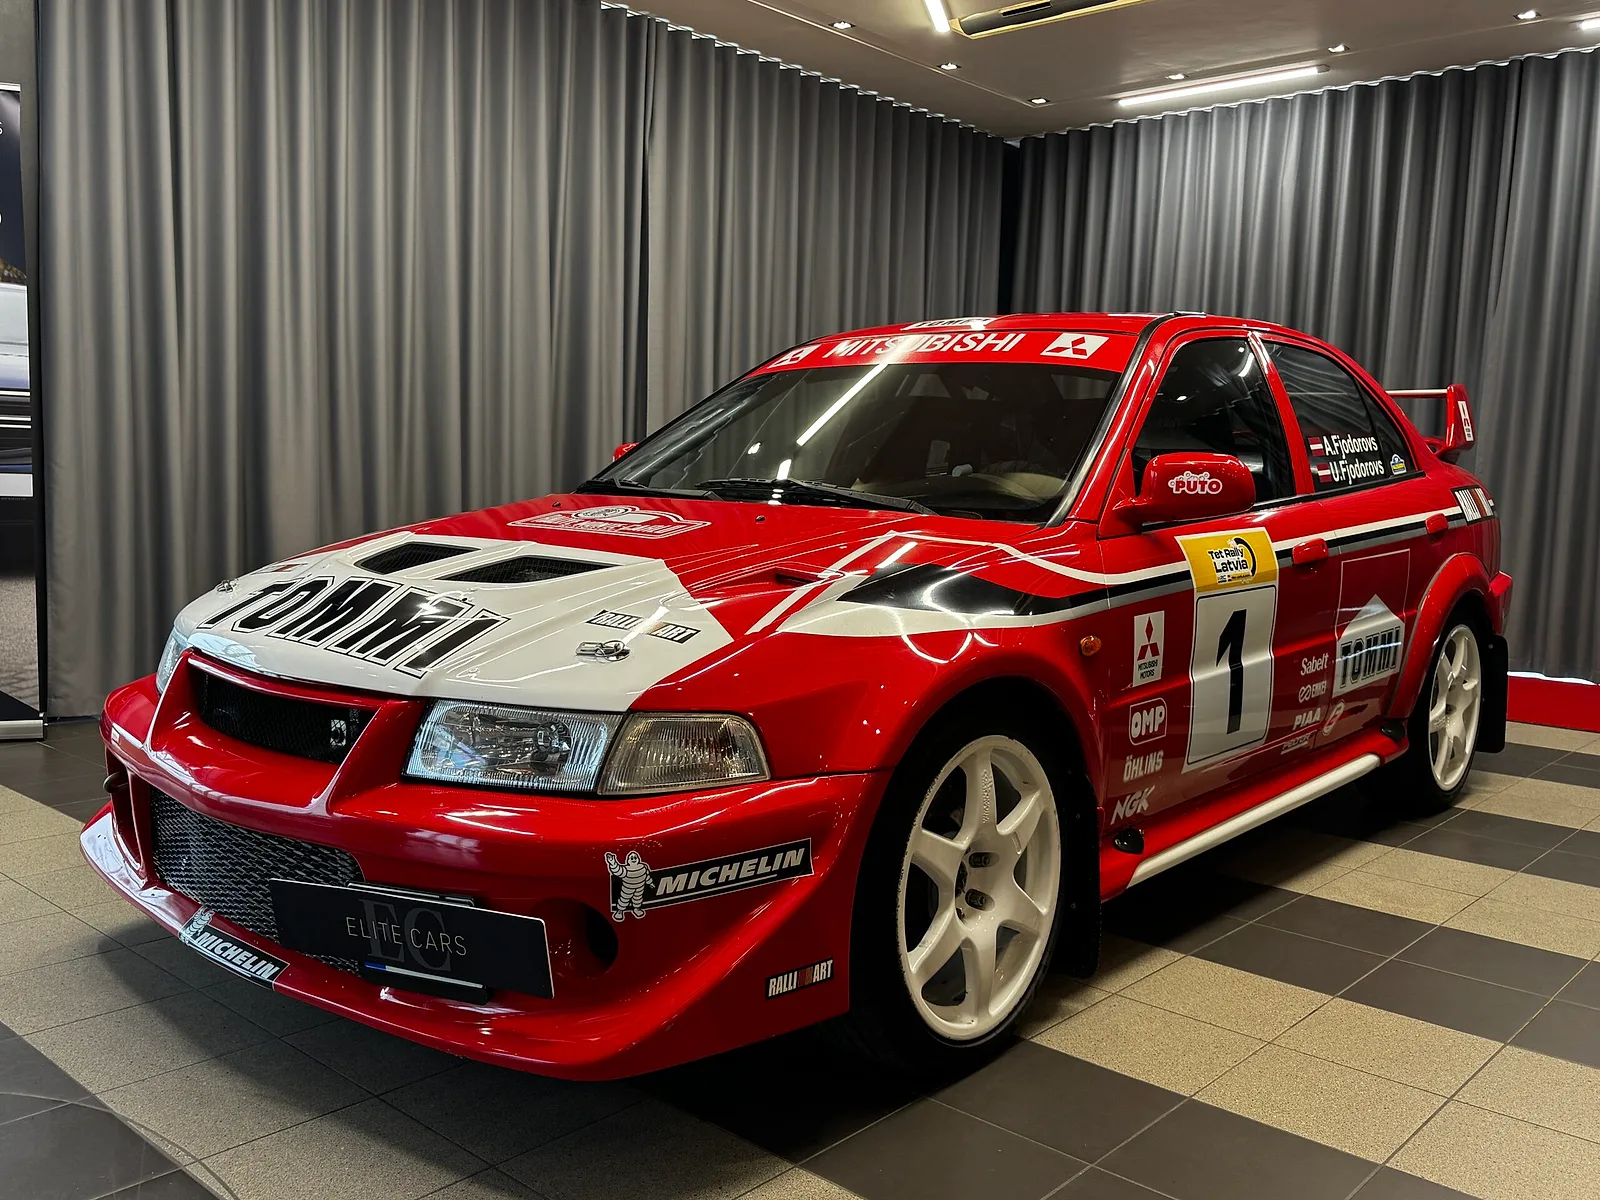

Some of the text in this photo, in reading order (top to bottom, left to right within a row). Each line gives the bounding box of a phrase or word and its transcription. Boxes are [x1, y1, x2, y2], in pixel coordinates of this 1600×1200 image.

[1323, 433, 1378, 459] A.Fjodorovs
[1174, 479, 1222, 494] PUTO
[1329, 458, 1384, 485] U.Fjodorovs
[1208, 547, 1244, 559] Tet Rally
[1213, 557, 1249, 573] Latvia
[196, 575, 511, 680] TOMMI
[1216, 608, 1247, 735] 1
[1300, 652, 1329, 676] Sabelt
[1340, 626, 1401, 689] TOMMI
[1140, 669, 1155, 680] MOTORS
[1131, 705, 1165, 738] OMP
[1292, 707, 1321, 731] PIAA
[1123, 750, 1164, 783] ÖHLINS
[1110, 785, 1155, 825] NGK
[656, 848, 805, 896] MICHELIN
[346, 916, 467, 956] ELITE CARS
[195, 931, 280, 979] MICHELIN
